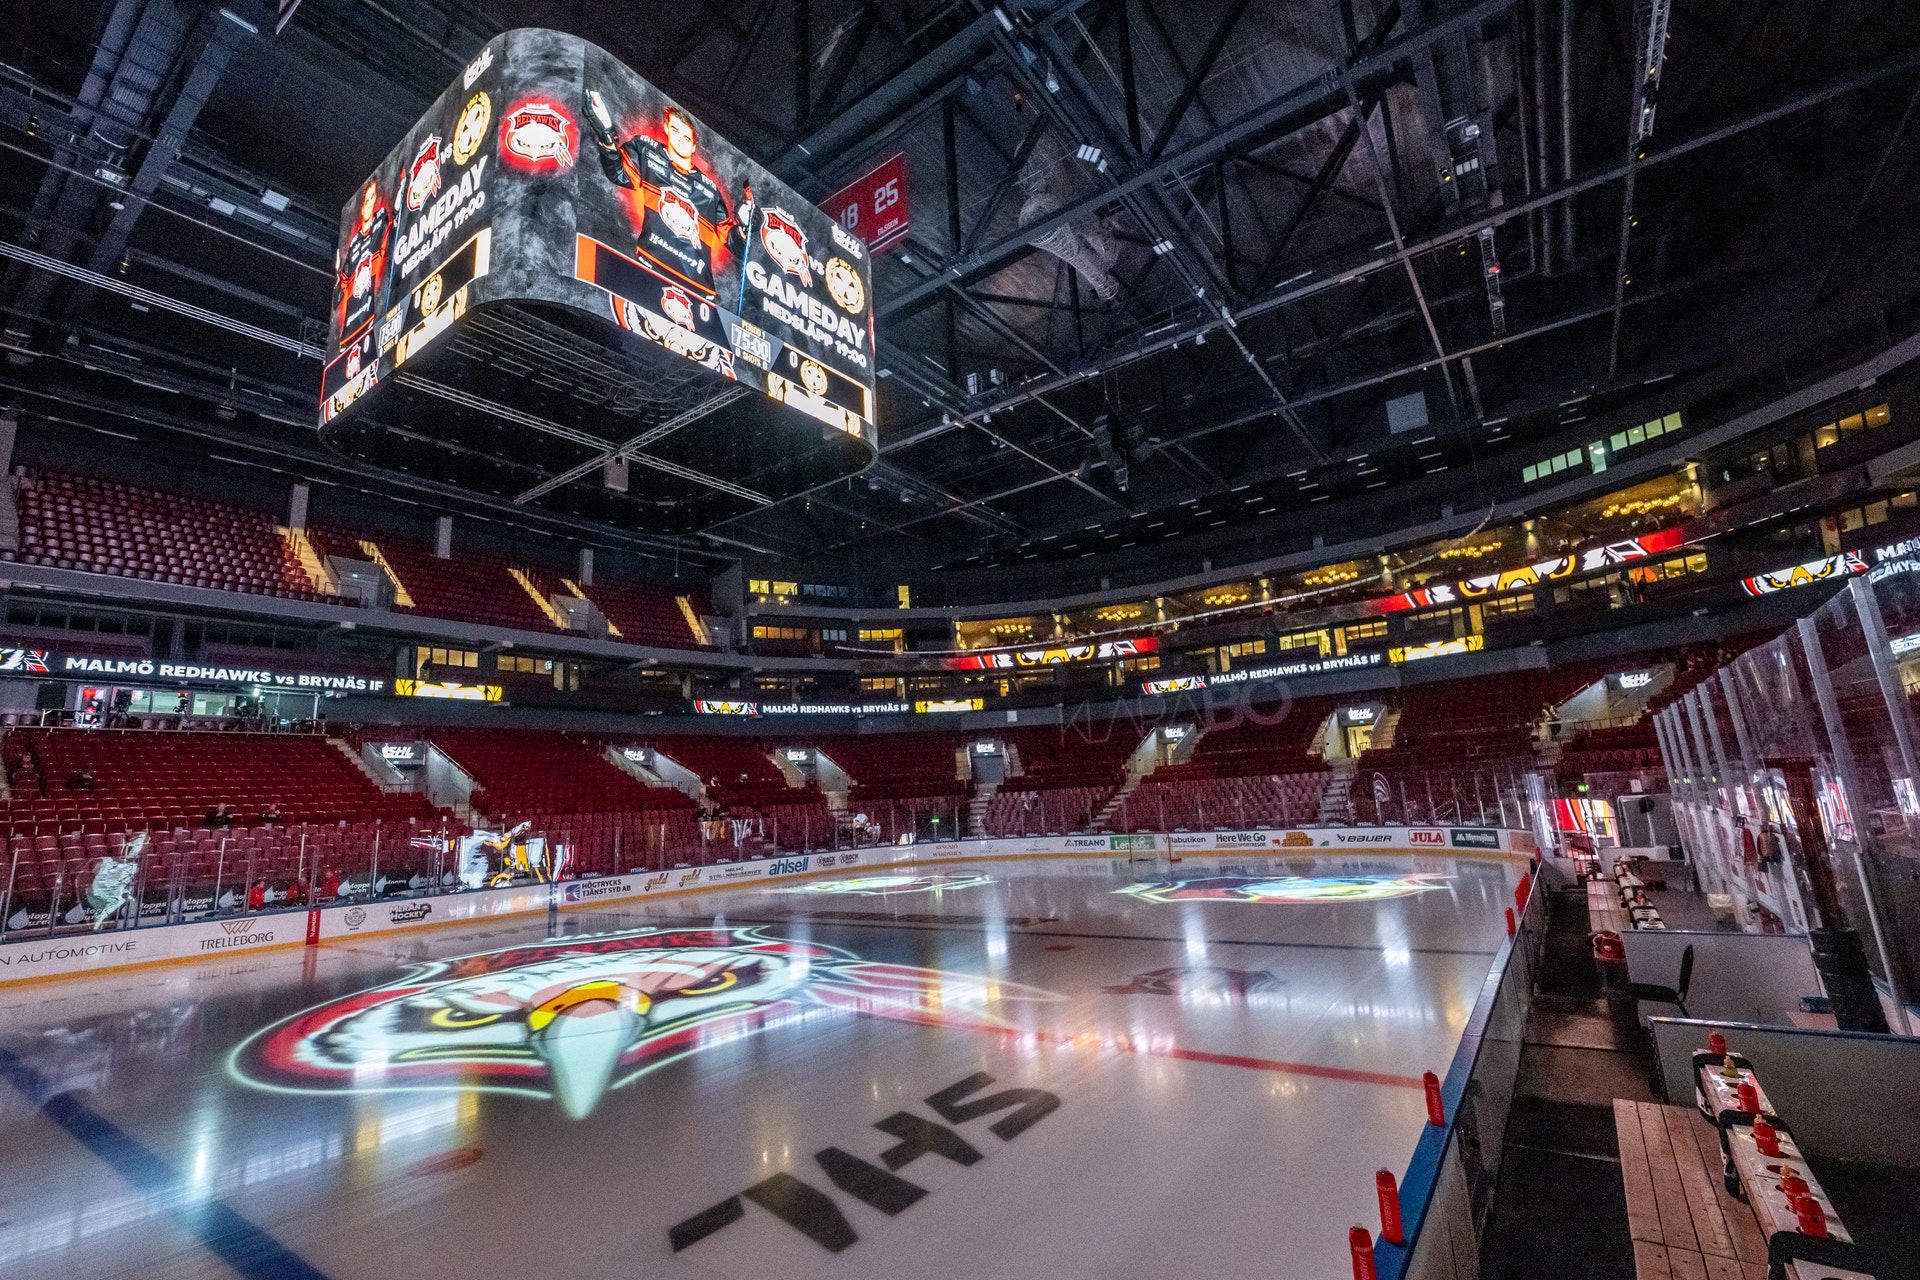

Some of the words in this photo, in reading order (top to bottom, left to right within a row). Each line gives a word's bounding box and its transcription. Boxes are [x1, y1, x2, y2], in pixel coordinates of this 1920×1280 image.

[874, 177, 898, 215] 25
[395, 154, 488, 264] GAMEDAY
[840, 203, 858, 231] 18
[401, 219, 453, 279] NEDSLÄPP
[454, 190, 486, 229] 19:00
[700, 303, 709, 322] 0
[746, 260, 865, 349] GAMEDAY
[741, 320, 761, 338] PERIOD
[763, 297, 833, 346] NEDSLÄPP
[835, 340, 866, 368] 19:00
[735, 328, 769, 359] 75:00
[742, 351, 761, 367] SHOTS
[790, 350, 798, 368] 0
[65, 658, 154, 675] MALMÖ
[160, 663, 271, 683] REDHAWKS
[275, 675, 296, 685] vs
[299, 675, 366, 691] BRYNÄS
[370, 680, 384, 692] IF
[1210, 670, 1248, 685] MALMÖ
[1249, 663, 1307, 680] REDHAWKS
[1309, 663, 1322, 672] vs
[1323, 655, 1364, 668] BRYNÄS
[1366, 653, 1380, 665] IF
[763, 703, 798, 713] MALMÖ
[800, 704, 850, 713] REDHAWKS
[851, 705, 861, 713] vs
[863, 703, 899, 713] BRYNÄS
[382, 743, 414, 759] SHL
[1073, 839, 1105, 847] TREANO
[1162, 836, 1206, 844] Vllabutiken
[1216, 833, 1237, 843] Here
[1238, 833, 1251, 842] We
[1253, 833, 1266, 842] Go
[1347, 834, 1392, 842] BAUER
[1410, 832, 1444, 843] JULA
[769, 856, 809, 876] ahlsell
[582, 879, 622, 889] HÖGTRYCKS
[644, 873, 669, 892] guld
[679, 868, 702, 887] guld
[582, 887, 607, 897] TJÄNST
[390, 910, 424, 920] HOCKEY
[200, 932, 274, 951] TRELLEBORG
[17, 941, 137, 965] AUTOMOTIVE
